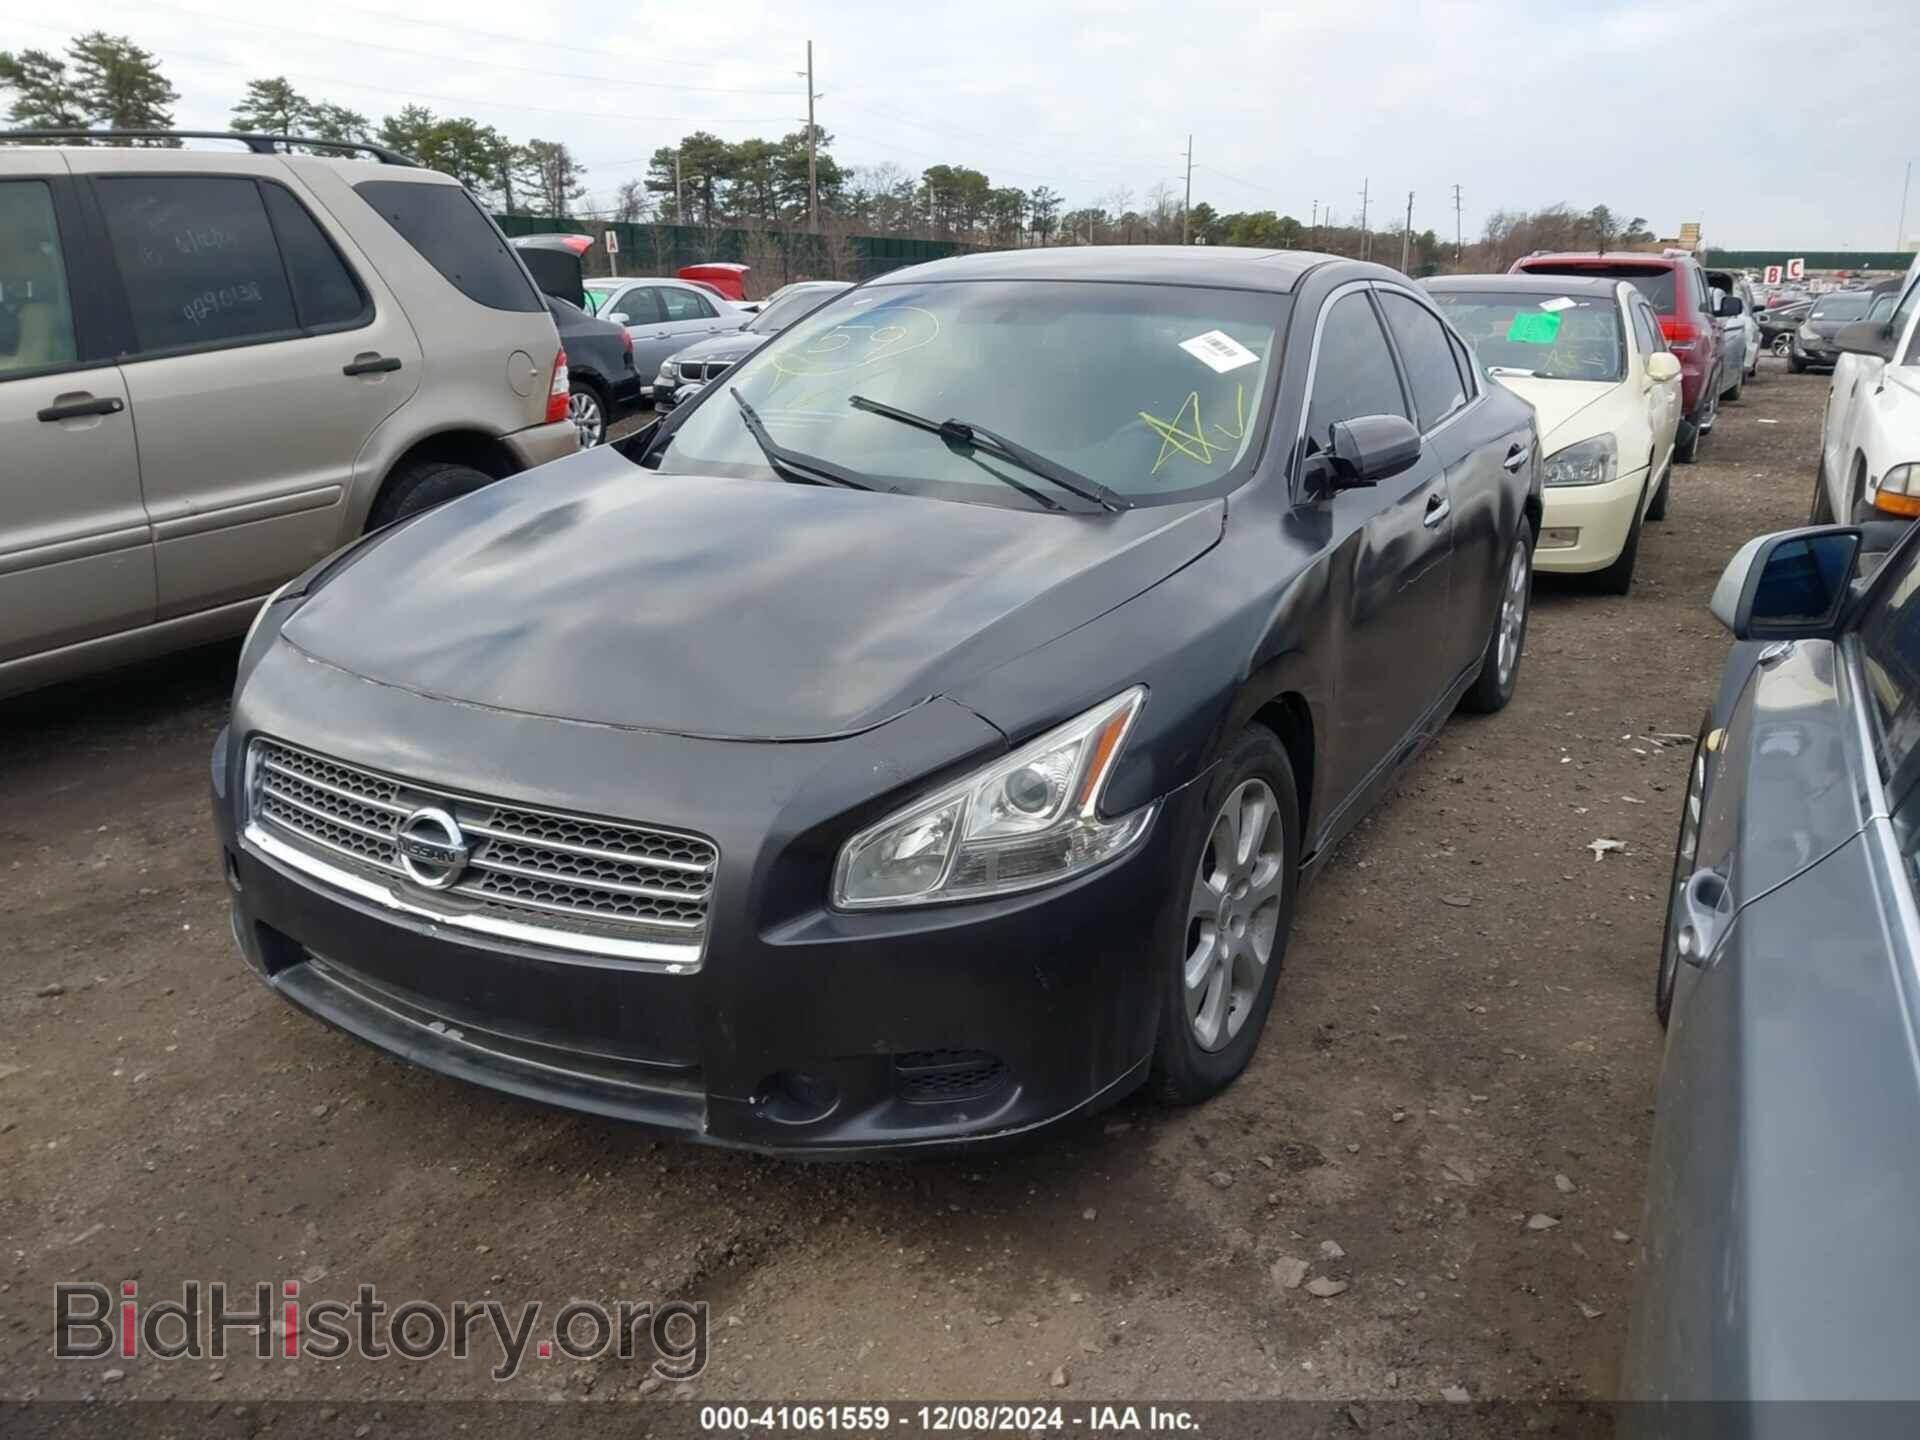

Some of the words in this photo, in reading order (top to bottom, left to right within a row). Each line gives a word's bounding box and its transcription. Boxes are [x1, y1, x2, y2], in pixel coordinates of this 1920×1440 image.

[1767, 267, 1779, 284] B
[1791, 260, 1801, 277] C
[398, 838, 459, 865] NISSAN
